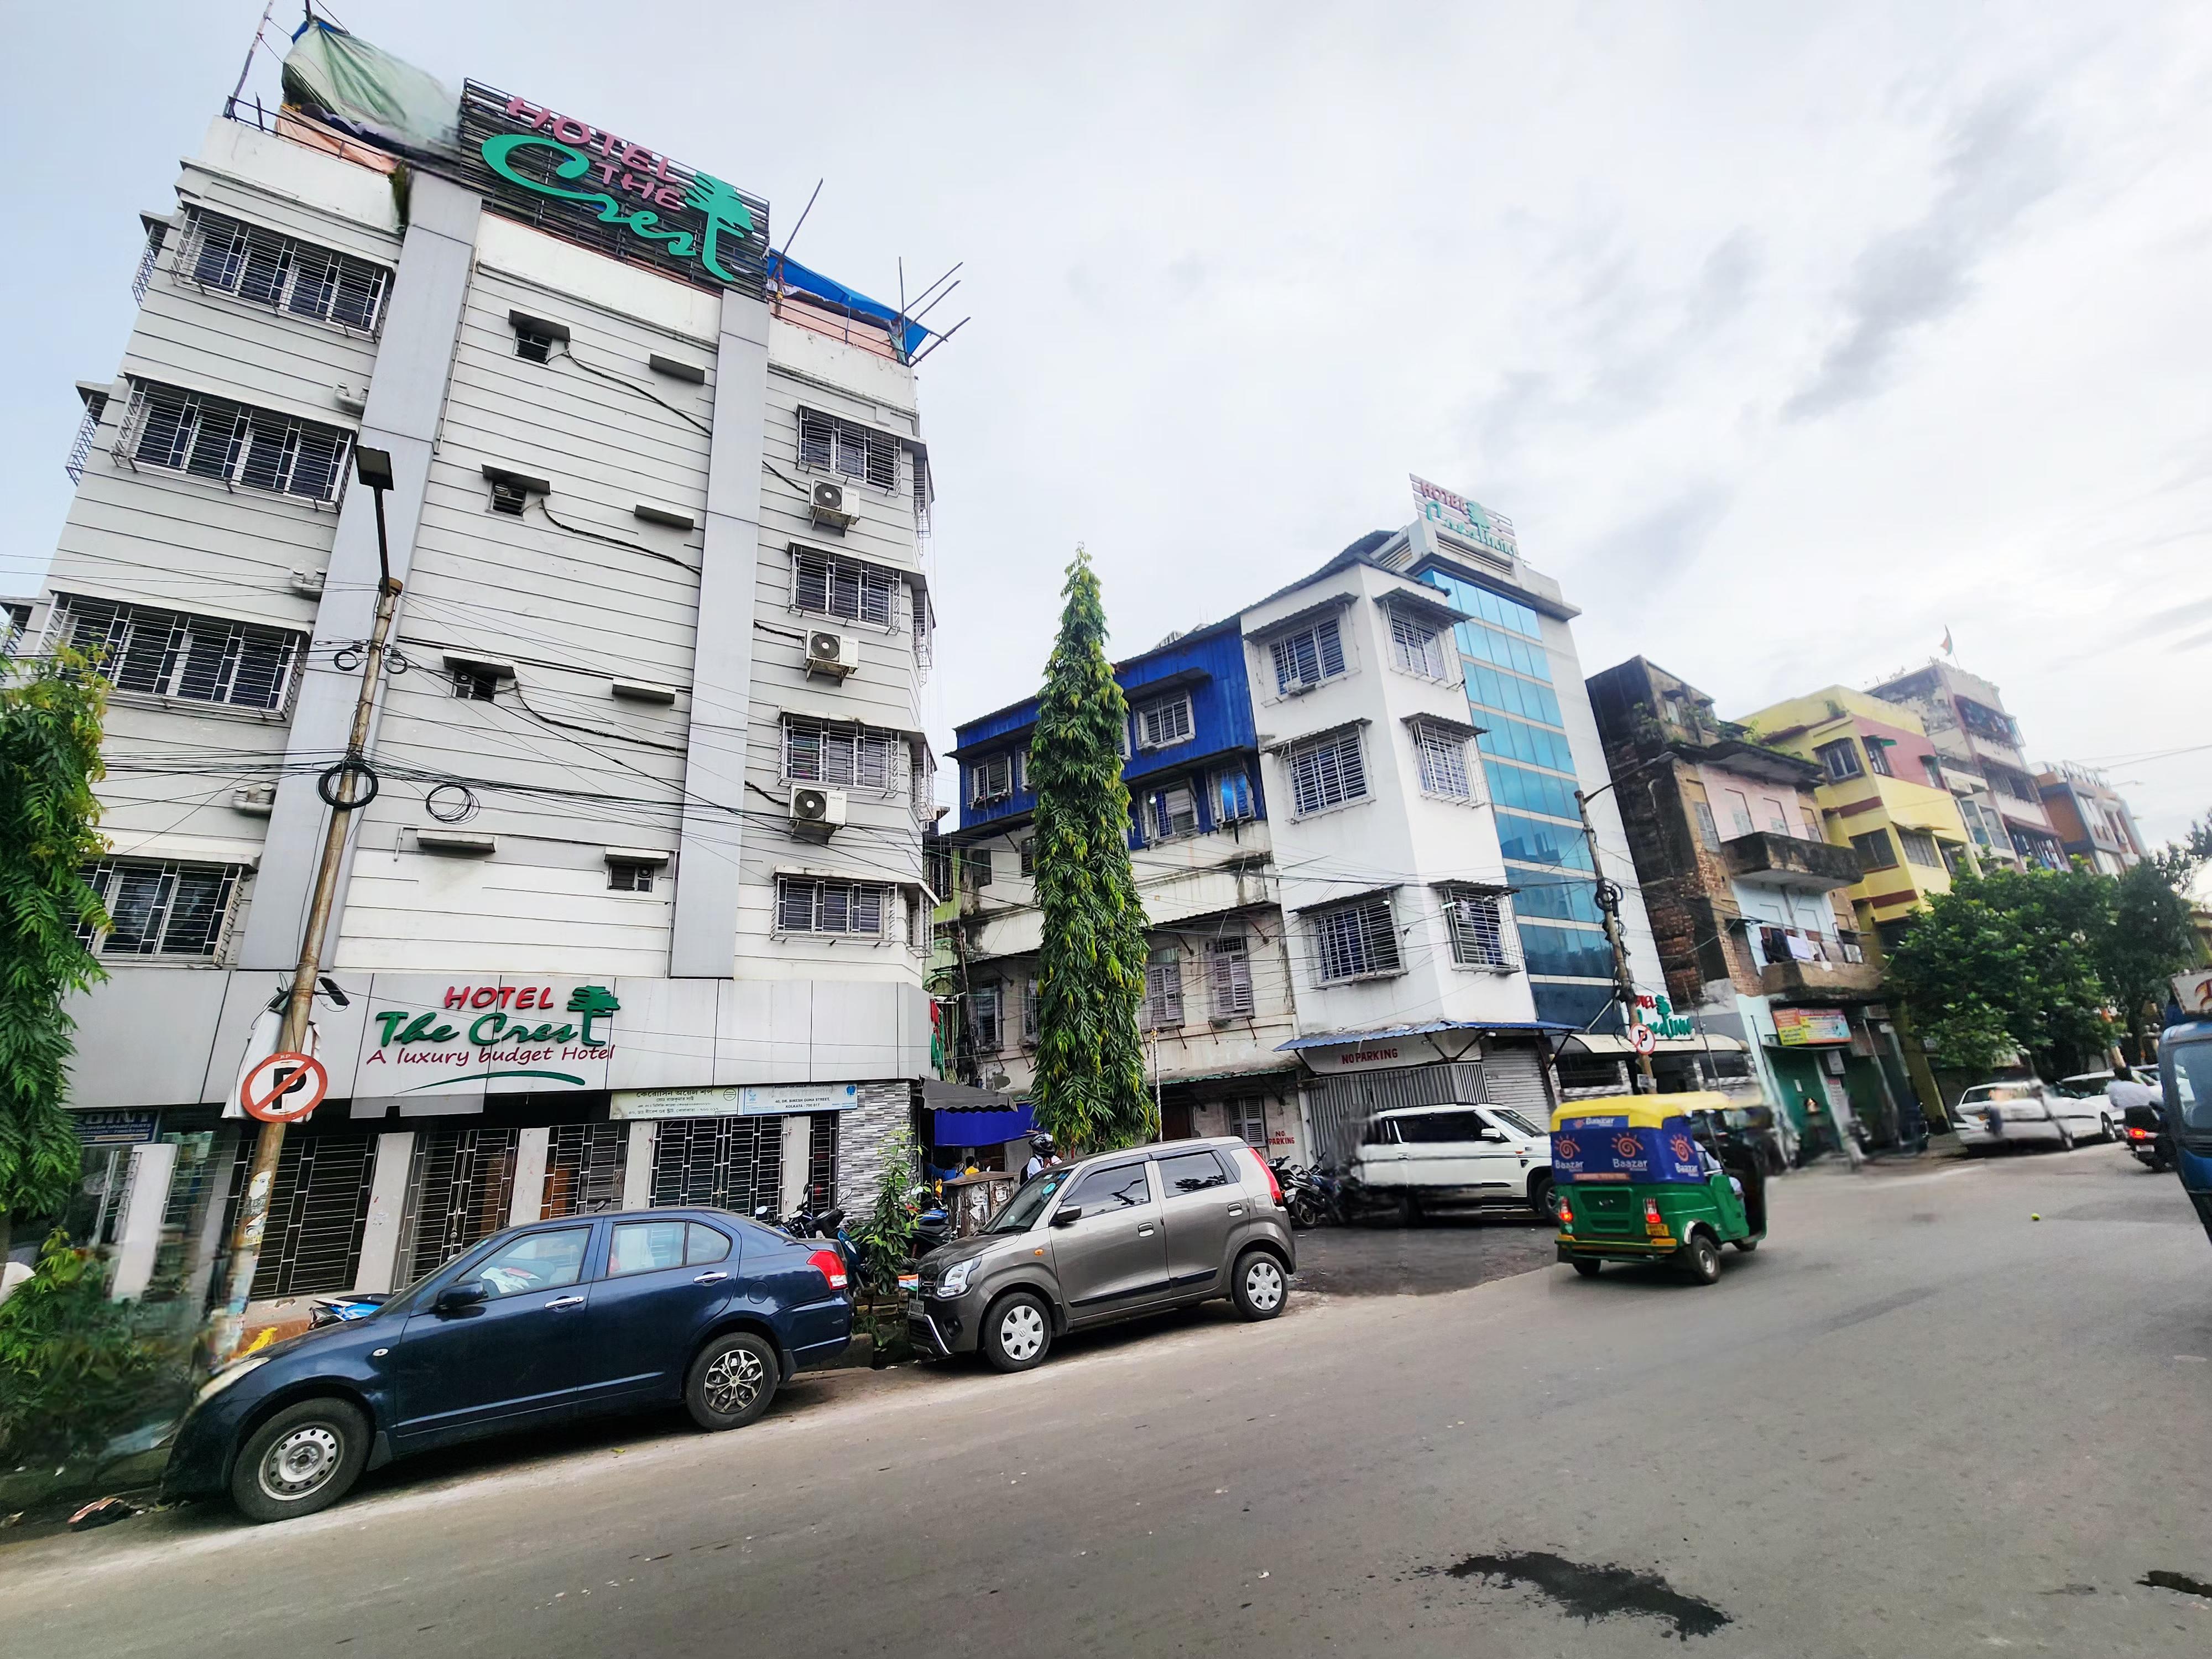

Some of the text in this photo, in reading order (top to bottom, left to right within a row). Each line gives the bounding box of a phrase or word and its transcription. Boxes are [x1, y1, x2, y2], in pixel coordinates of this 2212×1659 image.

[506, 96, 678, 185] HOTEL
[594, 163, 681, 212] THE
[481, 134, 753, 282] Crest
[1420, 479, 1468, 515] HOTEL
[445, 986, 554, 1009] HOTEL
[375, 985, 620, 1047] The Crest
[1638, 1030, 1648, 1047] P
[367, 1044, 615, 1066] A luxury budget Hotel
[1342, 1048, 1398, 1065] NO PARKING
[272, 1067, 307, 1110] P
[1555, 1160, 1584, 1169] Baazar
[1613, 1159, 1647, 1168] Baazar
[1674, 1163, 1698, 1173] Baazar
